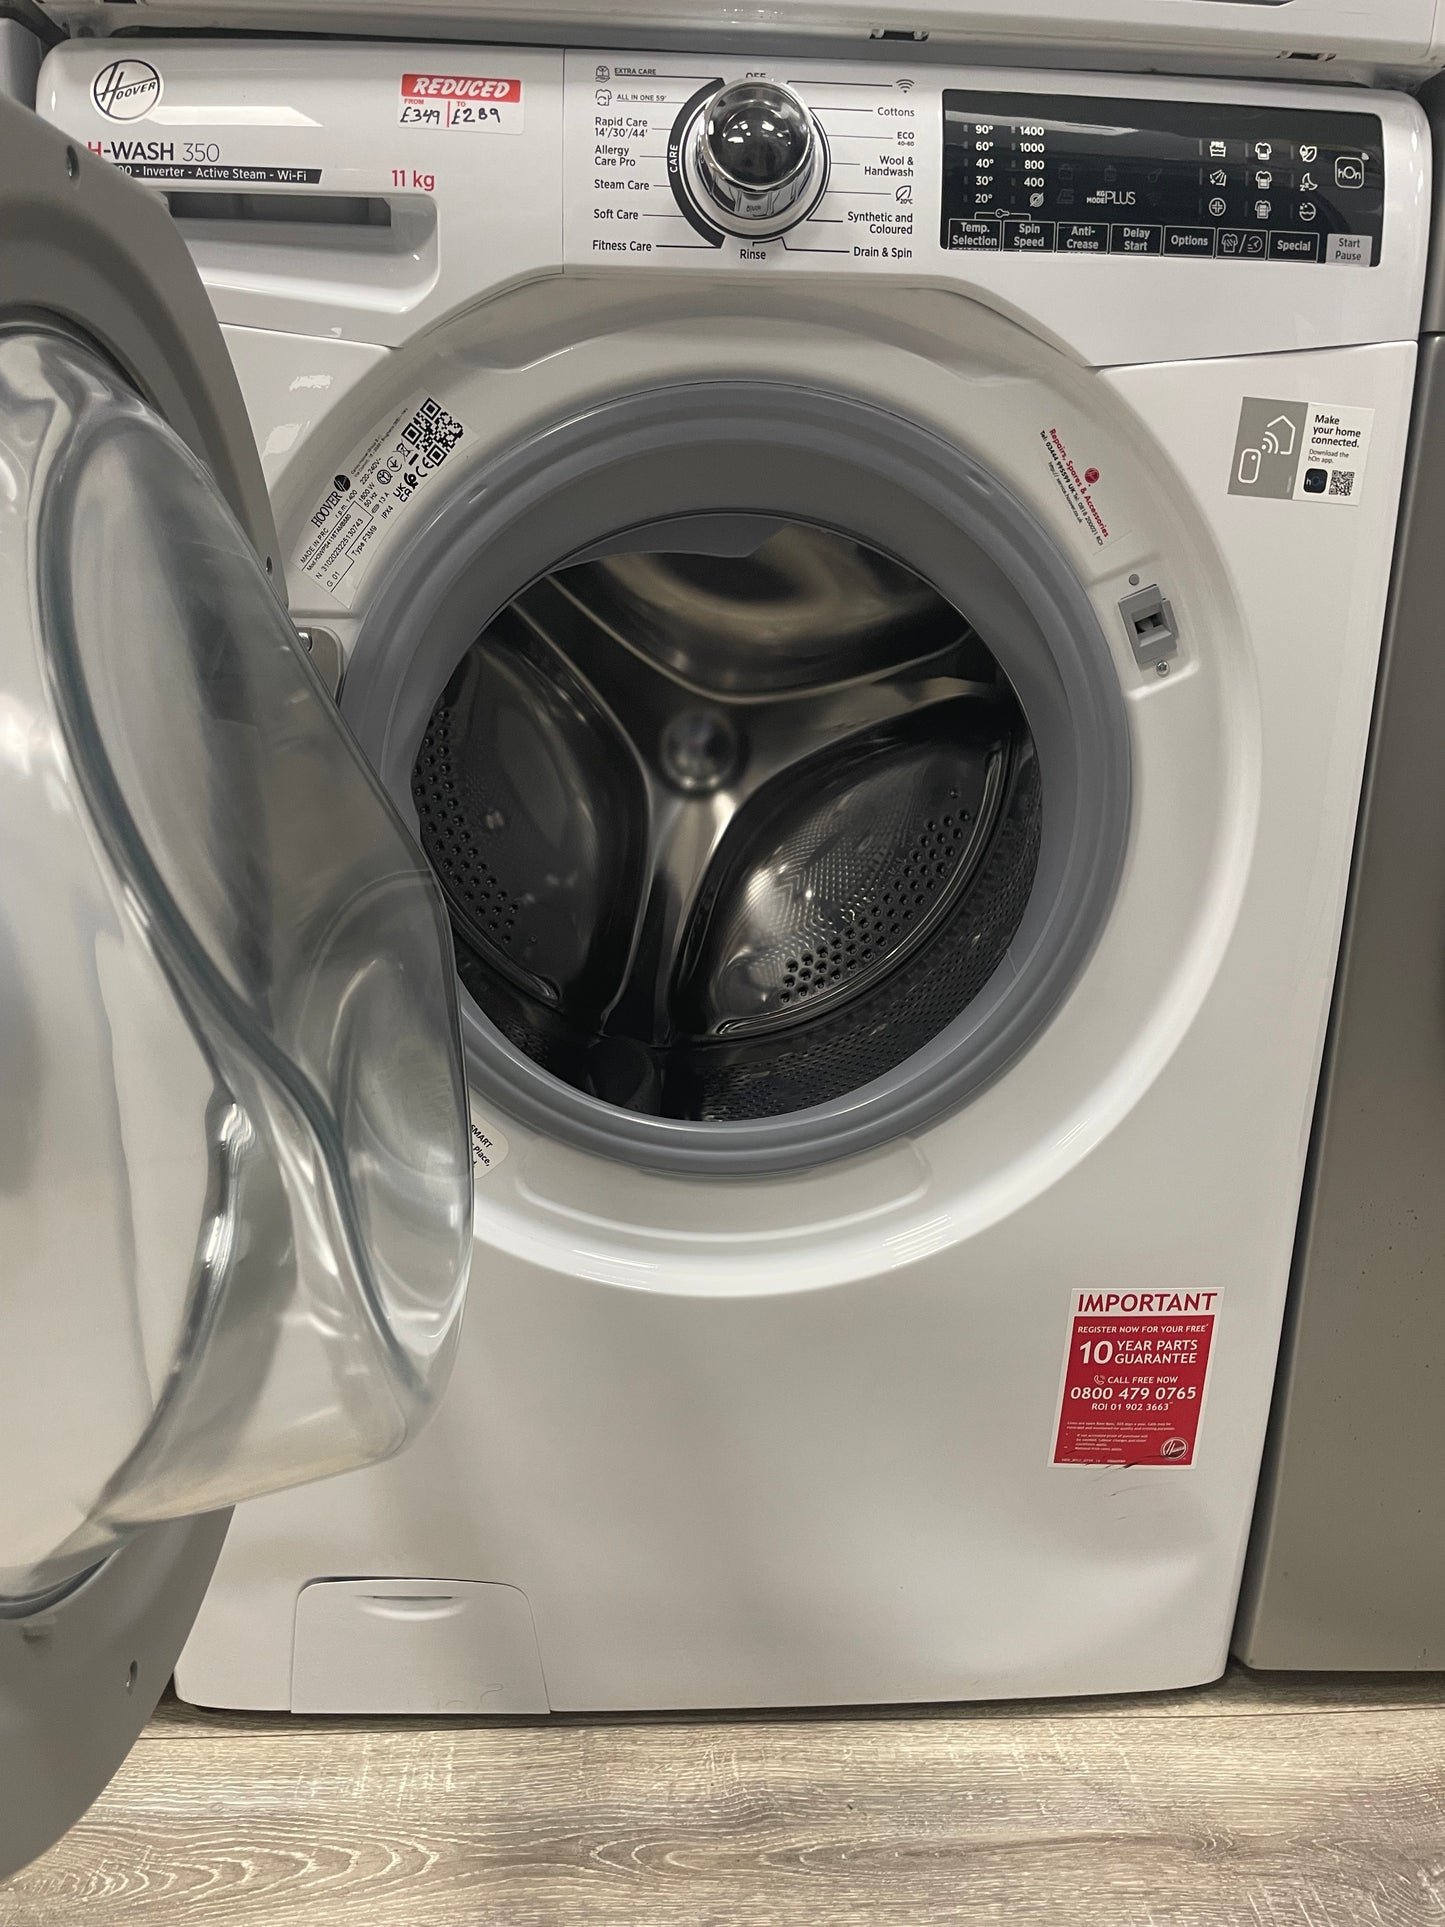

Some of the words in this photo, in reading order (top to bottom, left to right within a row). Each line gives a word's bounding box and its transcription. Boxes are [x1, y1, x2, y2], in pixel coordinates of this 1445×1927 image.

[614, 67, 636, 75] EXTRA
[638, 67, 657, 75] CARE
[412, 77, 510, 98] REDUCED
[400, 106, 440, 125] £349
[451, 107, 500, 125] £289
[877, 107, 915, 117] Cottons
[595, 116, 623, 128] Rapid
[626, 117, 648, 127] Care
[897, 131, 915, 140] ECO
[975, 124, 994, 135] 90°
[1019, 125, 1045, 136] 1400
[88, 141, 174, 161] H-WASH
[182, 142, 220, 163] 350
[594, 144, 630, 156] Allergy
[975, 141, 994, 151] 60°
[1019, 142, 1045, 153] 1000
[594, 156, 617, 166] Care
[619, 157, 636, 166] Pro
[669, 143, 679, 173] CARE
[879, 155, 905, 165] Wool
[906, 156, 914, 165] &
[975, 158, 994, 168] 40°
[1024, 159, 1045, 170] 800
[143, 165, 185, 178] Inverter
[195, 167, 229, 179] Active
[232, 168, 266, 180] Steam
[277, 169, 307, 182] Wi-Fi
[864, 166, 914, 177] Handwash
[1337, 165, 1362, 180] hOn
[392, 169, 405, 187] 11
[413, 169, 435, 192] kg
[594, 179, 625, 190] Steam
[627, 180, 650, 190] Care
[975, 175, 994, 186] 30°
[1023, 177, 1045, 188] 400
[975, 193, 993, 204] 20°
[1105, 190, 1136, 205] PLUS
[593, 208, 614, 219] Soft
[616, 209, 639, 220] Care
[847, 211, 893, 223] Synthetic
[895, 213, 913, 223] and
[869, 223, 913, 235] Coloured
[960, 222, 990, 234] Temp.
[1018, 223, 1040, 235] Spin
[1071, 225, 1096, 236] Anti-
[1123, 227, 1151, 239] Delay
[592, 239, 627, 251] Fitness
[629, 240, 652, 252] Care
[952, 234, 998, 247] Selection
[1013, 236, 1045, 248] Speed
[1066, 238, 1099, 250] Crease
[1124, 239, 1148, 251] Start
[1170, 233, 1209, 249] Options
[1277, 240, 1311, 252] Special
[1338, 237, 1361, 248] Start
[740, 248, 767, 260] Rinse
[853, 246, 879, 258] Drain
[881, 247, 889, 258] &
[891, 247, 913, 260] Spin
[1335, 250, 1362, 261] Pause
[1315, 414, 1340, 426] Make
[1312, 425, 1334, 436] your
[1335, 426, 1361, 438] home
[1311, 436, 1360, 448] connected.
[1309, 448, 1339, 458] Download
[368, 482, 375, 490] W
[1049, 428, 1067, 460] Repairs,
[1066, 460, 1082, 487] Spares
[1084, 495, 1109, 538] Accessories
[1068, 483, 1076, 494] UK
[346, 489, 357, 502] 1400
[370, 492, 377, 500] Hz
[393, 483, 406, 497] UK
[311, 491, 342, 528] HOOVER
[381, 505, 393, 519] IPX4
[300, 546, 315, 563] MADE
[317, 528, 329, 540] PRC
[351, 542, 365, 556] Type
[332, 571, 340, 580] 01
[473, 1145, 491, 1167] Place,
[1077, 1292, 1218, 1313] IMPORTANT
[1077, 1326, 1117, 1334] REGISTER
[1119, 1325, 1140, 1334] NOW
[1141, 1325, 1159, 1333] FOR
[1161, 1325, 1184, 1333] YOUR
[1079, 1340, 1114, 1365] 10
[1117, 1340, 1153, 1351] YEAR
[1156, 1339, 1198, 1351] PARTS
[1114, 1353, 1198, 1364] GUARANTEE
[1107, 1376, 1130, 1384] CALL
[1132, 1376, 1154, 1384] FREE
[1156, 1376, 1178, 1384] NOW
[1070, 1387, 1113, 1400] 0800
[1118, 1387, 1150, 1400] 479
[1155, 1386, 1197, 1400] 0765
[1091, 1402, 1109, 1411] ROI
[1110, 1402, 1122, 1411] 01
[1125, 1402, 1143, 1411] 902
